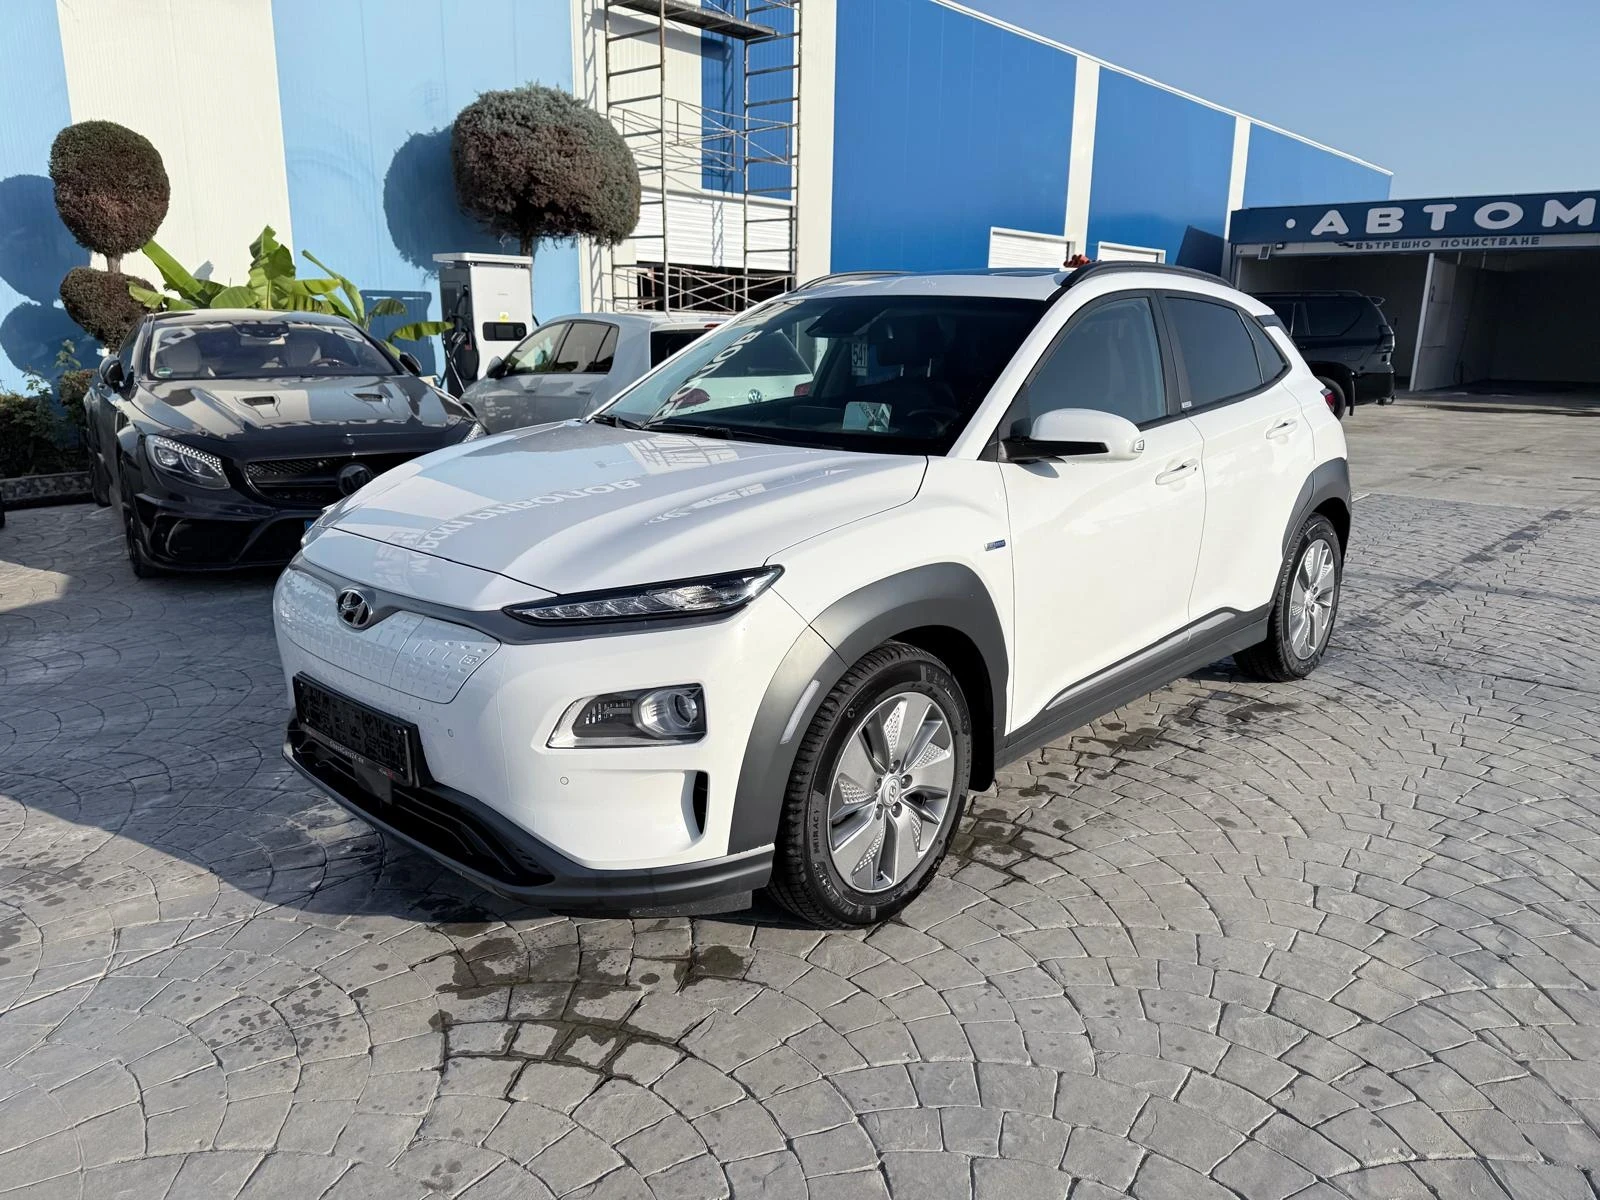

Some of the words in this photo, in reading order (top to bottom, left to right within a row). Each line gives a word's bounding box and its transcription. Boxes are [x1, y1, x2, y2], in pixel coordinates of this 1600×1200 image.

[1311, 198, 1597, 236] АВТОМ
[1355, 239, 1432, 250] ВЪТРЕШНО
[1440, 236, 1541, 249] ПОЧИСТВАНЕ
